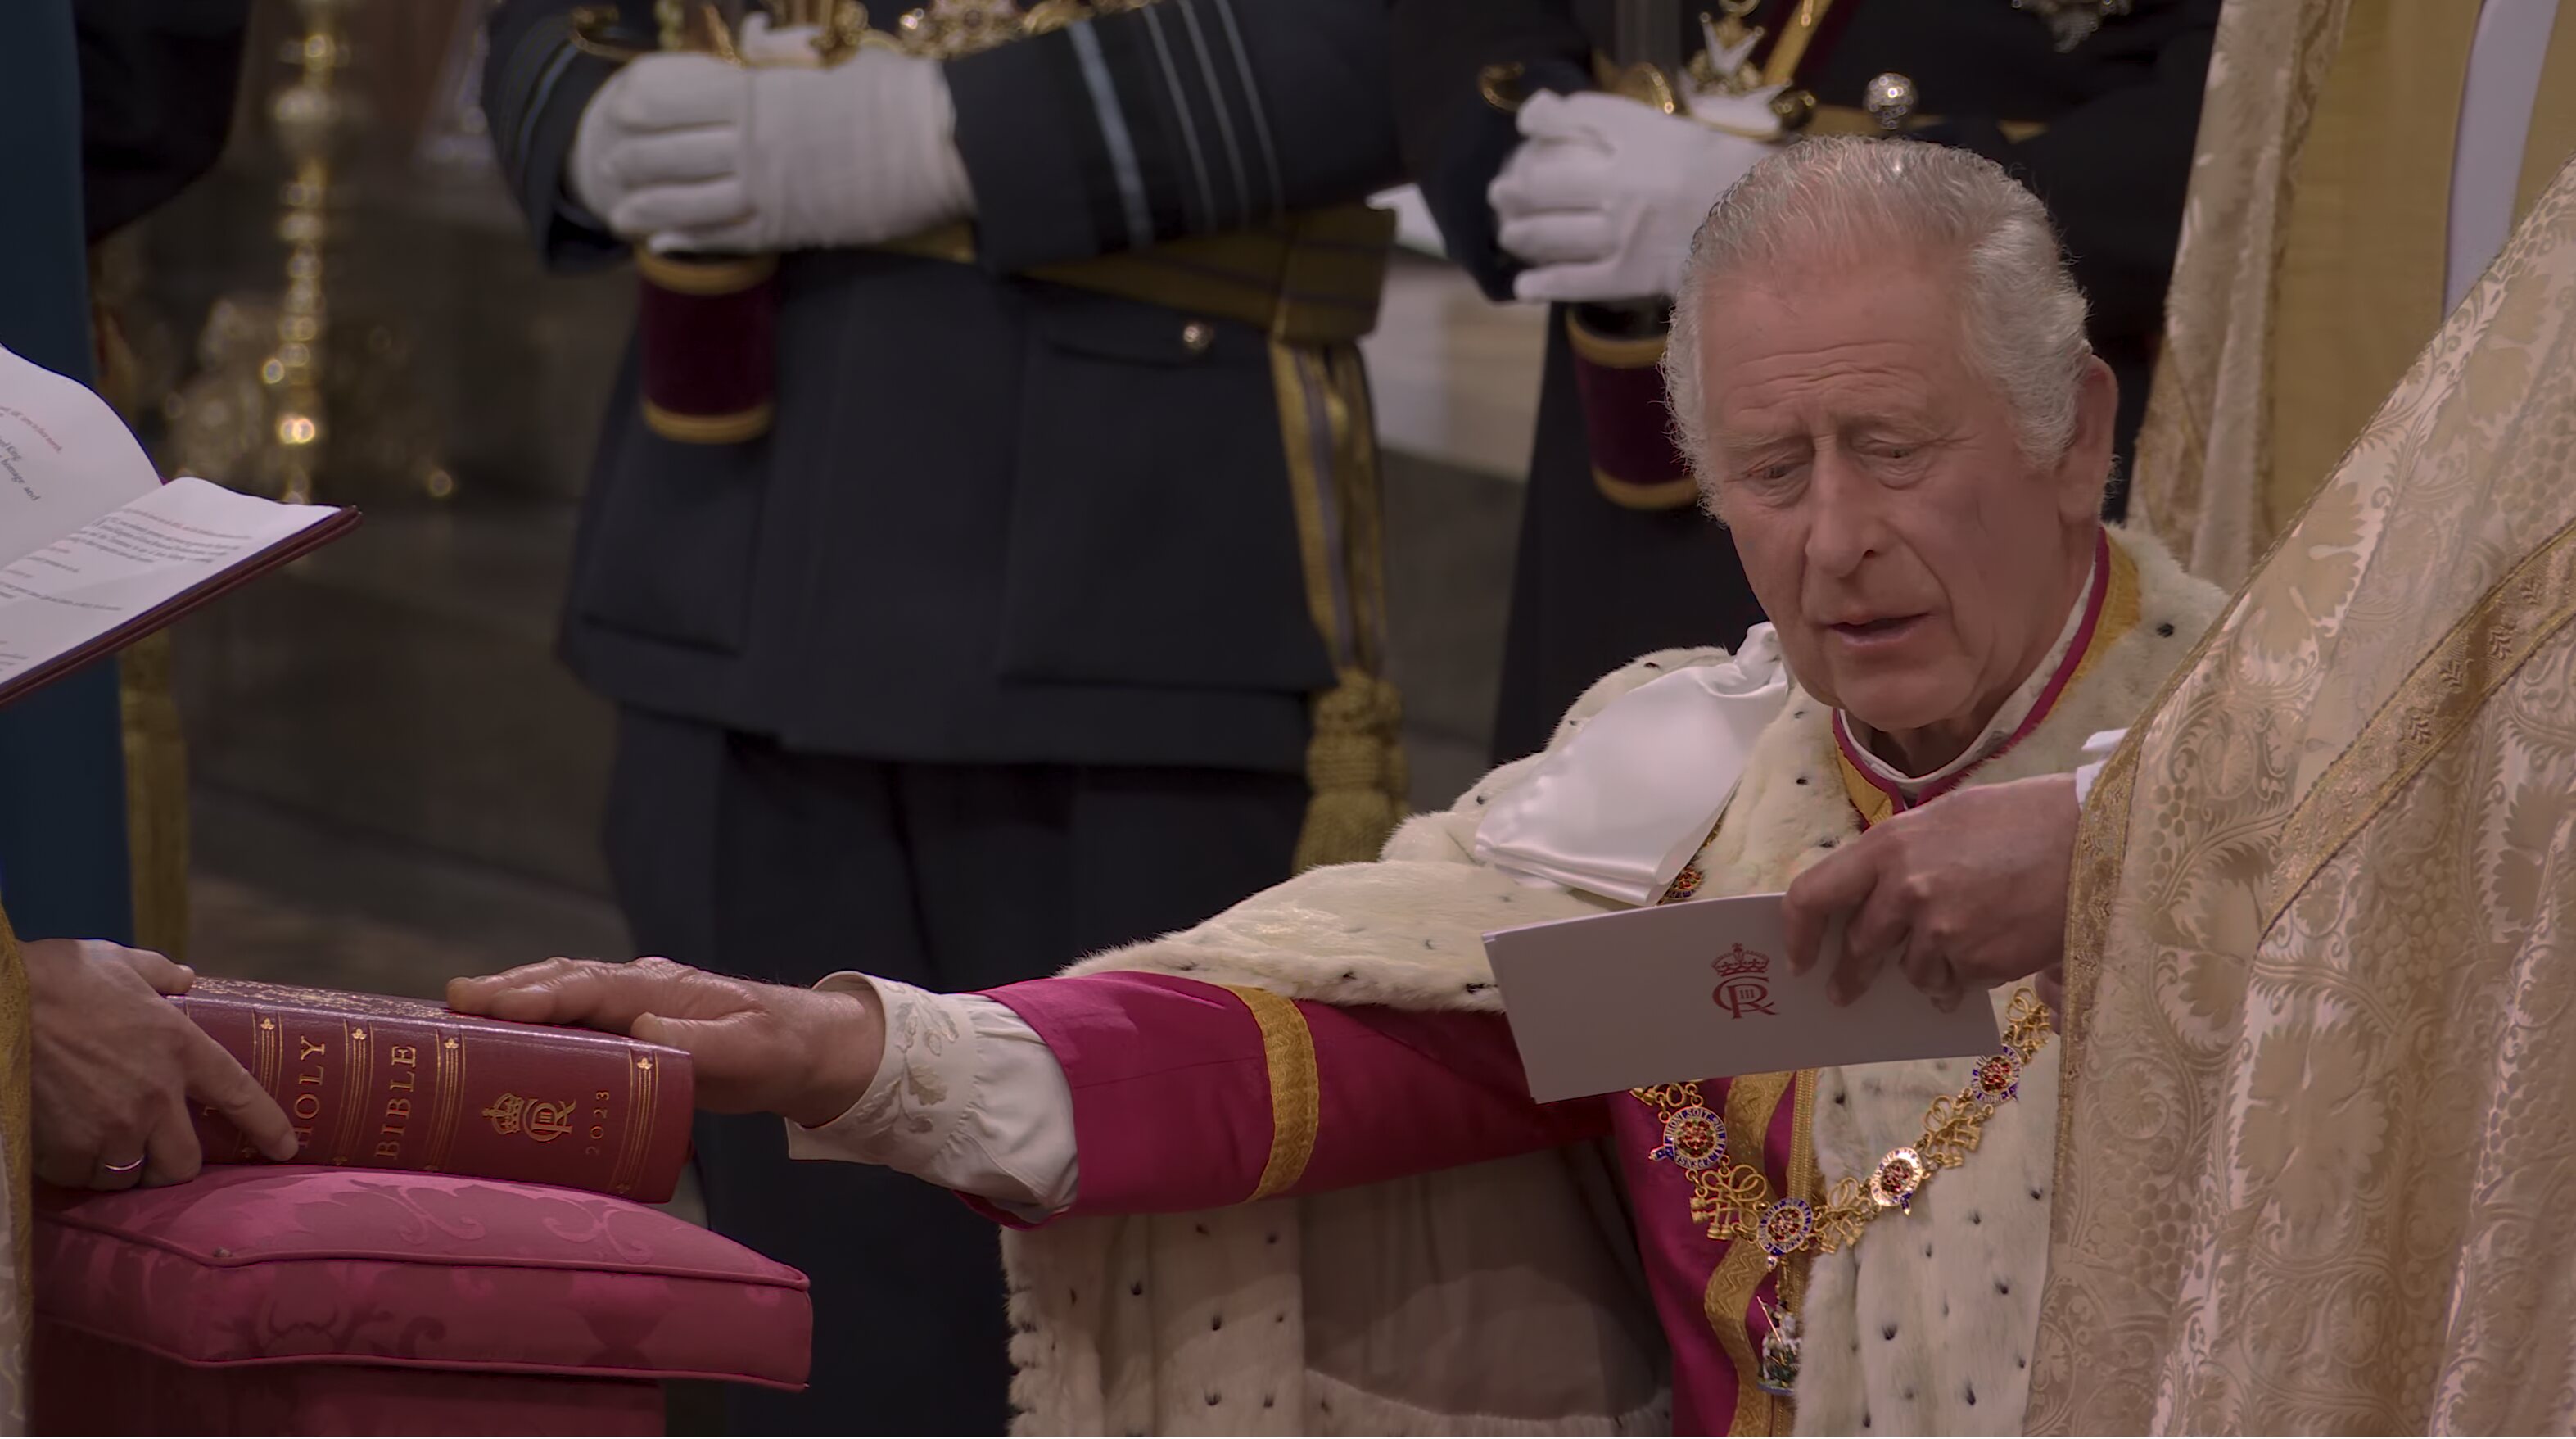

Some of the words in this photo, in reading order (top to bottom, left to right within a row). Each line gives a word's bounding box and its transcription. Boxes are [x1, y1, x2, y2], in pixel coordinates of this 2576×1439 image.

[293, 1035, 326, 1148] HOLY
[374, 1045, 418, 1161] BIBLE
[585, 1091, 610, 1156] 2023
